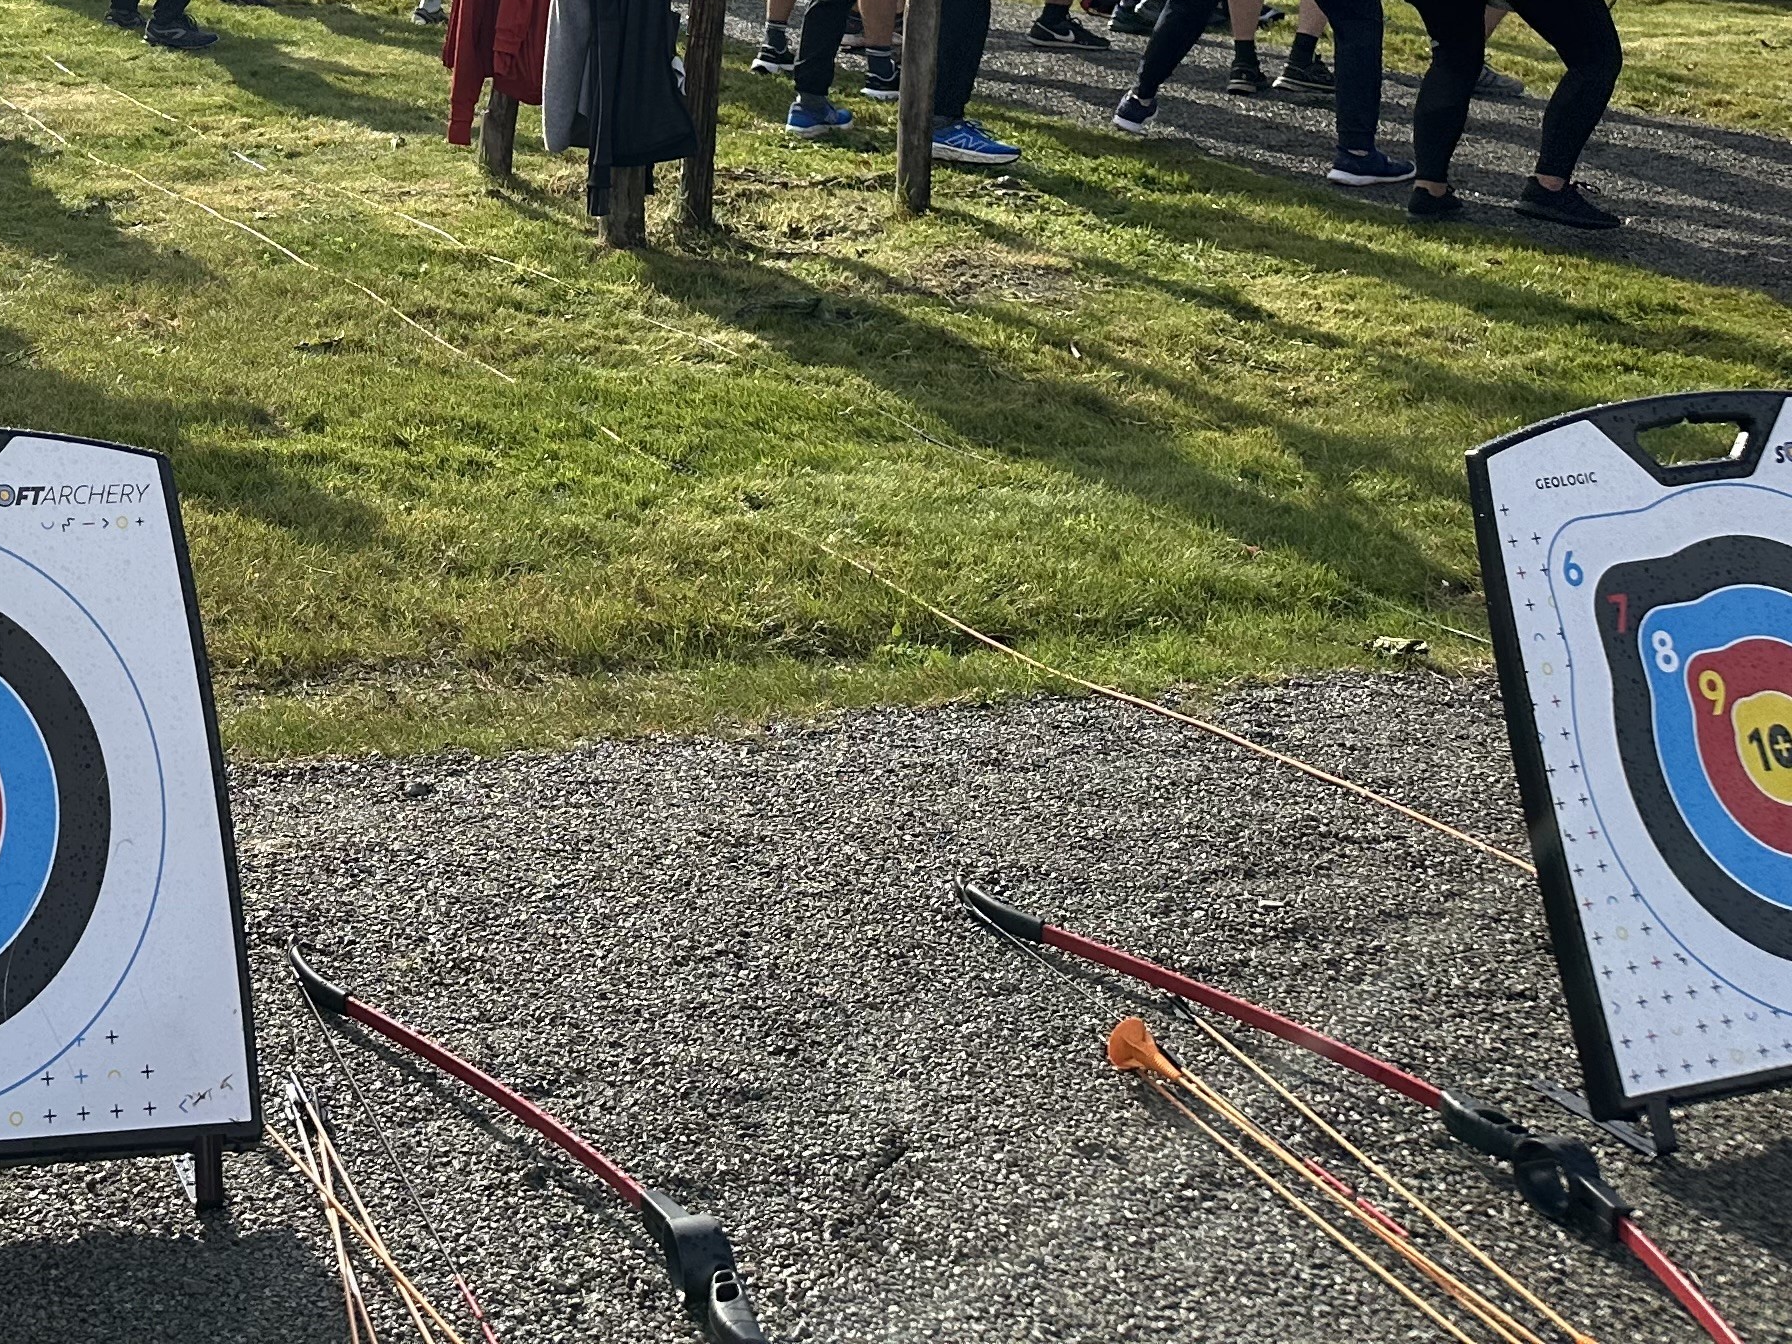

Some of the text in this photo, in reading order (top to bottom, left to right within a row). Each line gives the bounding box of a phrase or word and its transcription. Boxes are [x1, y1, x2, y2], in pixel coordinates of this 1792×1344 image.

[1535, 470, 1598, 490] GEOLOGIC
[1563, 550, 1584, 587] 6
[1608, 594, 1628, 634] 7
[1651, 630, 1680, 673] 8
[1698, 669, 1726, 716] 9
